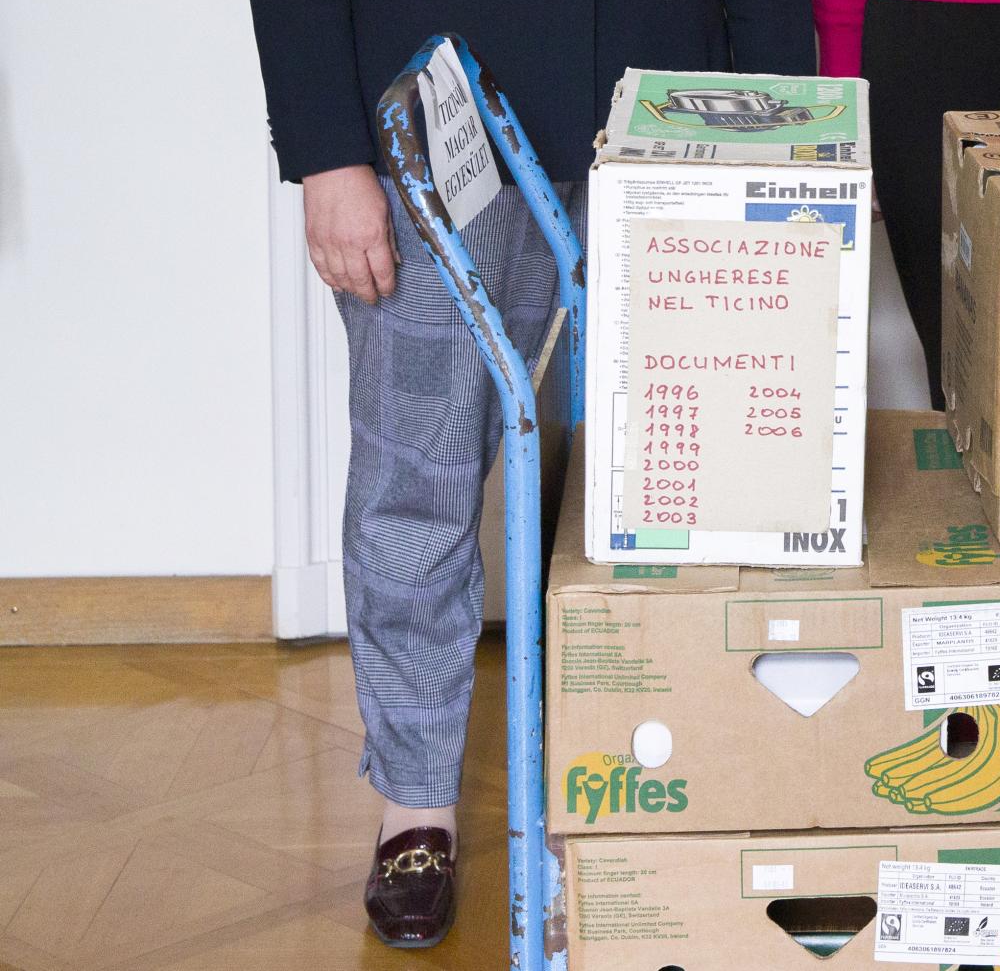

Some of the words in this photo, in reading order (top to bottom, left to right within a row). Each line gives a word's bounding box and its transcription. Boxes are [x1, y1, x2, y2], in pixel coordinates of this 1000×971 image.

[444, 115, 478, 163] MAGYAR
[445, 143, 491, 203] EGYESÜLET
[746, 182, 857, 199] Einhell
[646, 236, 830, 258] ASSOCIAZIONE
[649, 269, 790, 285] UNGHERESE
[649, 296, 693, 310] NEL
[706, 294, 789, 311] TICINO
[644, 354, 796, 371] DOCUMENTI
[644, 384, 699, 400] 1996
[749, 386, 801, 400] 2004
[645, 405, 699, 419] 1997
[747, 407, 802, 419] 2005
[645, 424, 699, 438] 1998
[745, 424, 802, 437] 2006
[644, 441, 700, 456] 1999
[643, 459, 699, 471] 2000
[642, 477, 696, 491] 2001
[643, 495, 698, 508] 2002
[643, 511, 697, 525] 2003
[783, 529, 846, 552] INOX
[567, 767, 688, 824] fyffes
